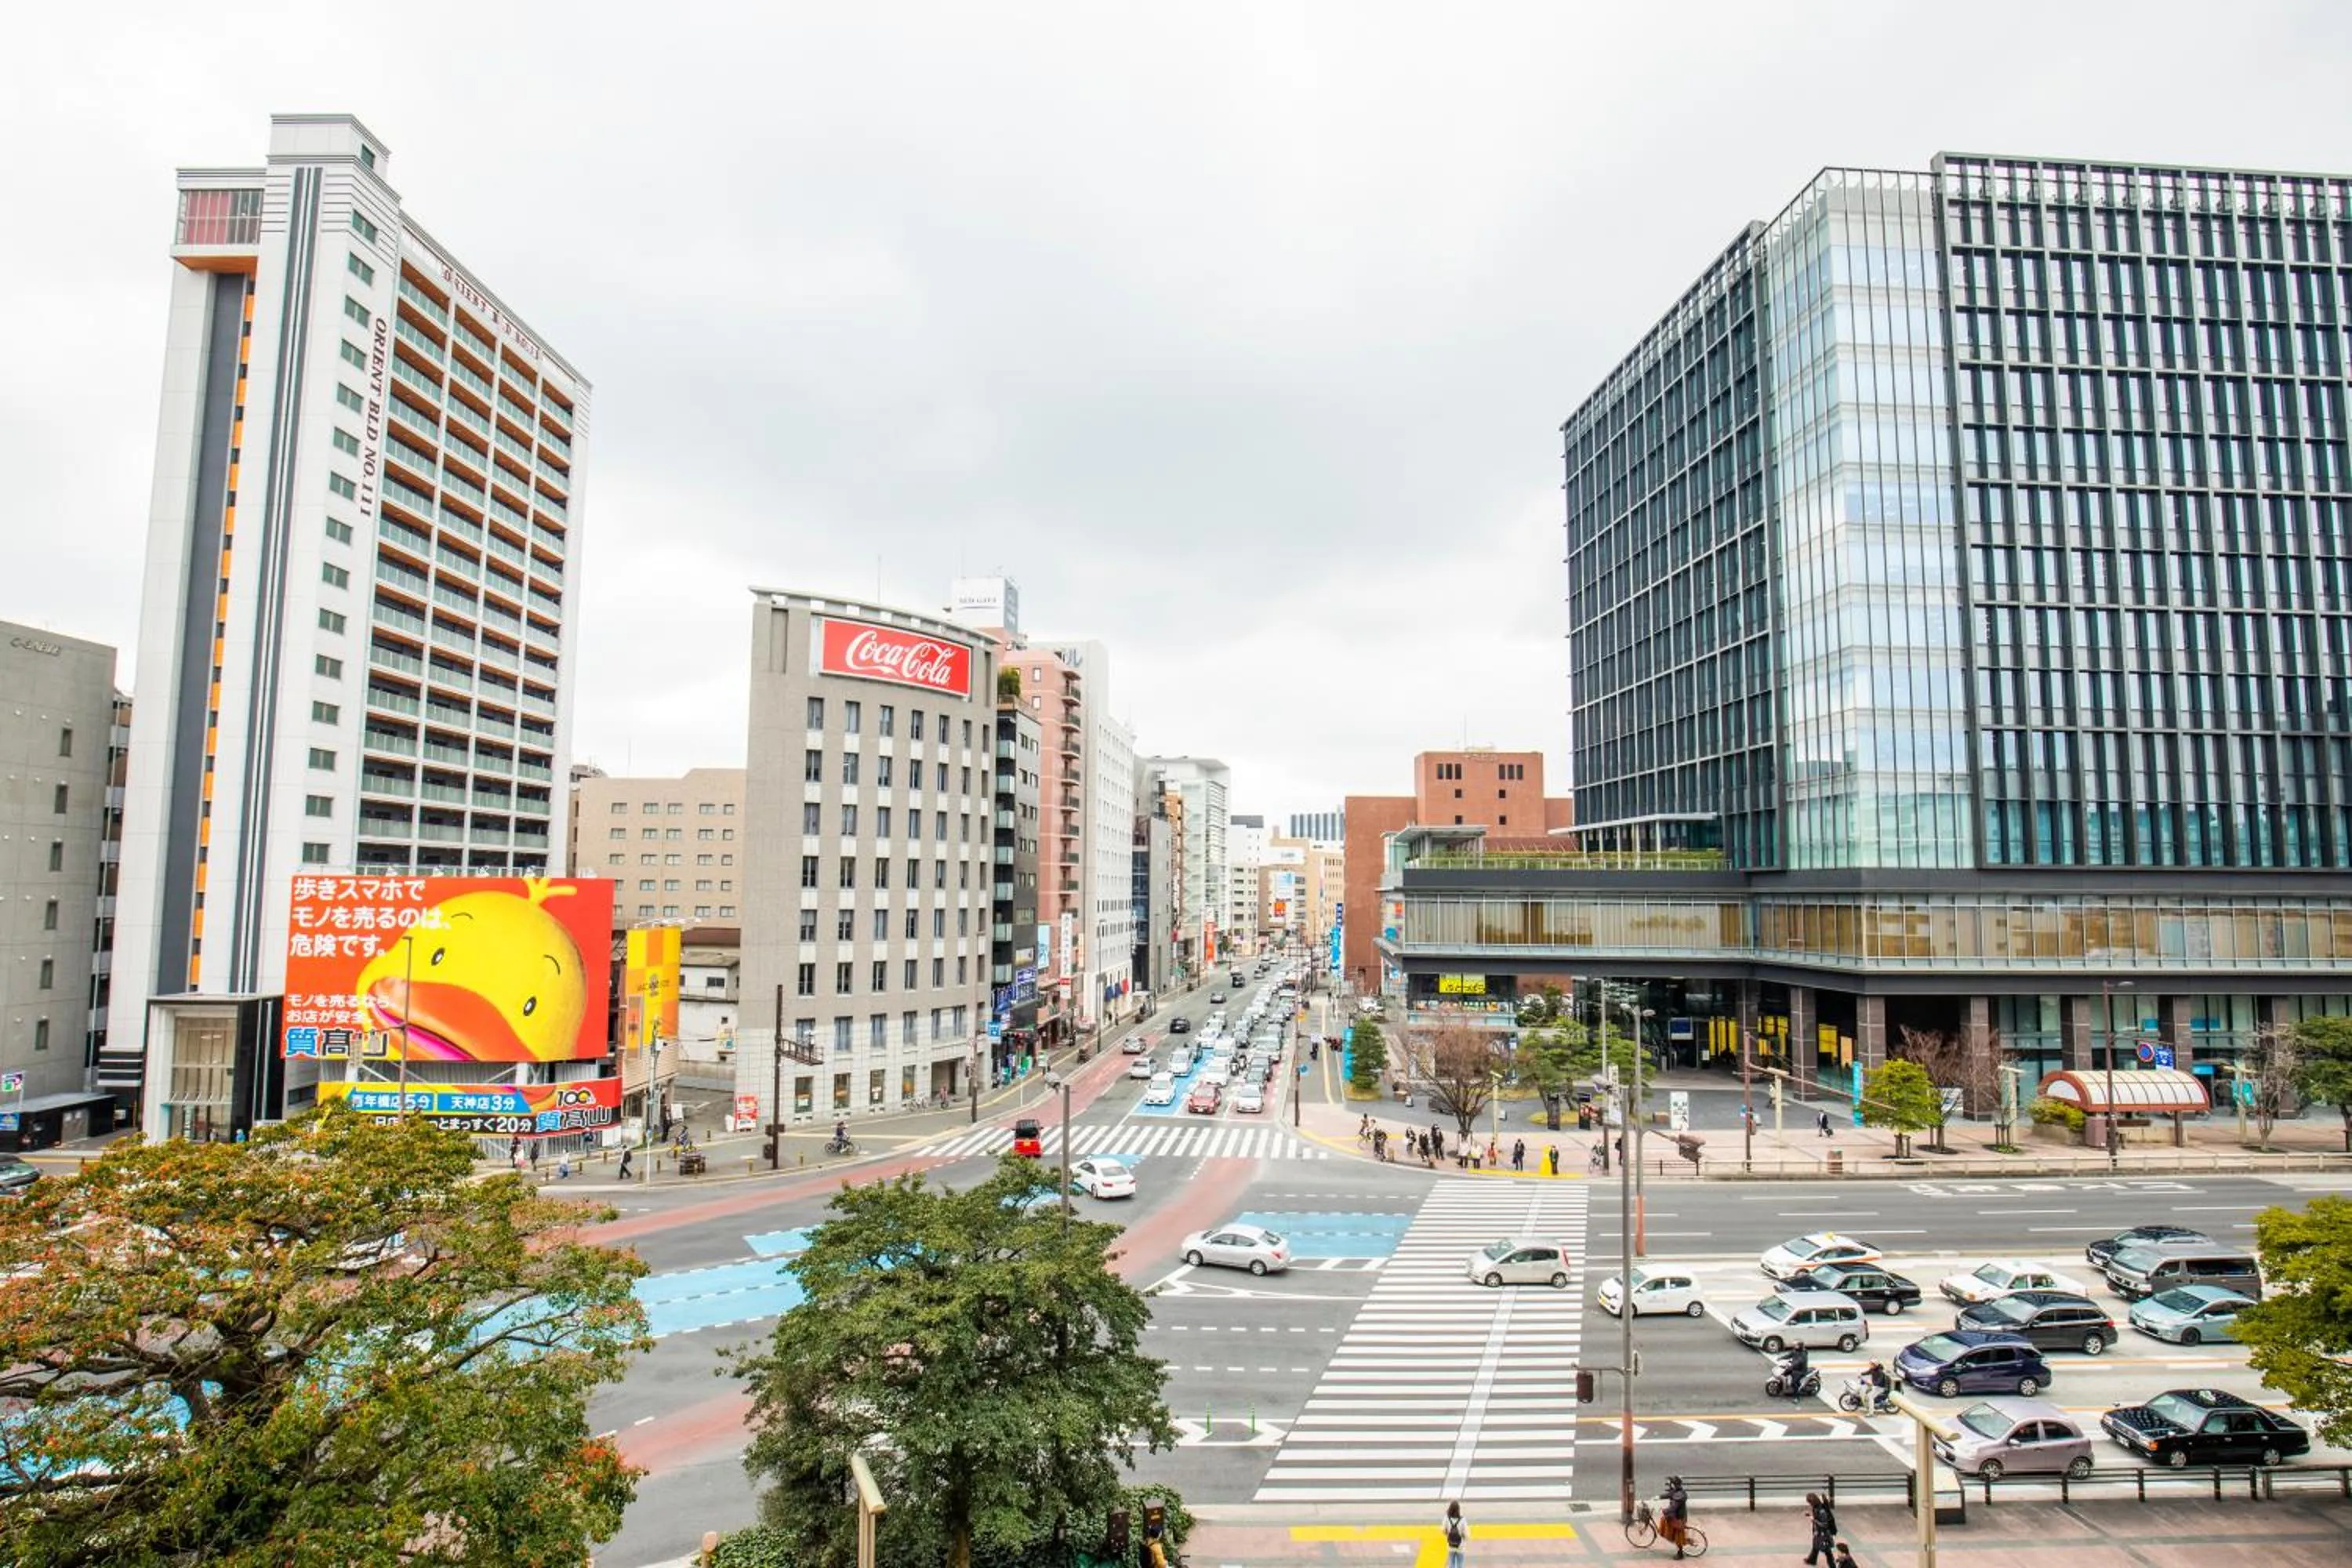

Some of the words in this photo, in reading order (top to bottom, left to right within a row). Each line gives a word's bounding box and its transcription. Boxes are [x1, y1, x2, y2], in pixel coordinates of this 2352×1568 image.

[368, 317, 387, 397] ORIENT
[365, 397, 381, 444] BLD
[294, 878, 426, 901] 歩きスマホで
[292, 906, 452, 929] モノを売るのは、
[290, 932, 387, 957] 危険です。
[451, 1094, 515, 1111] 天神店3分
